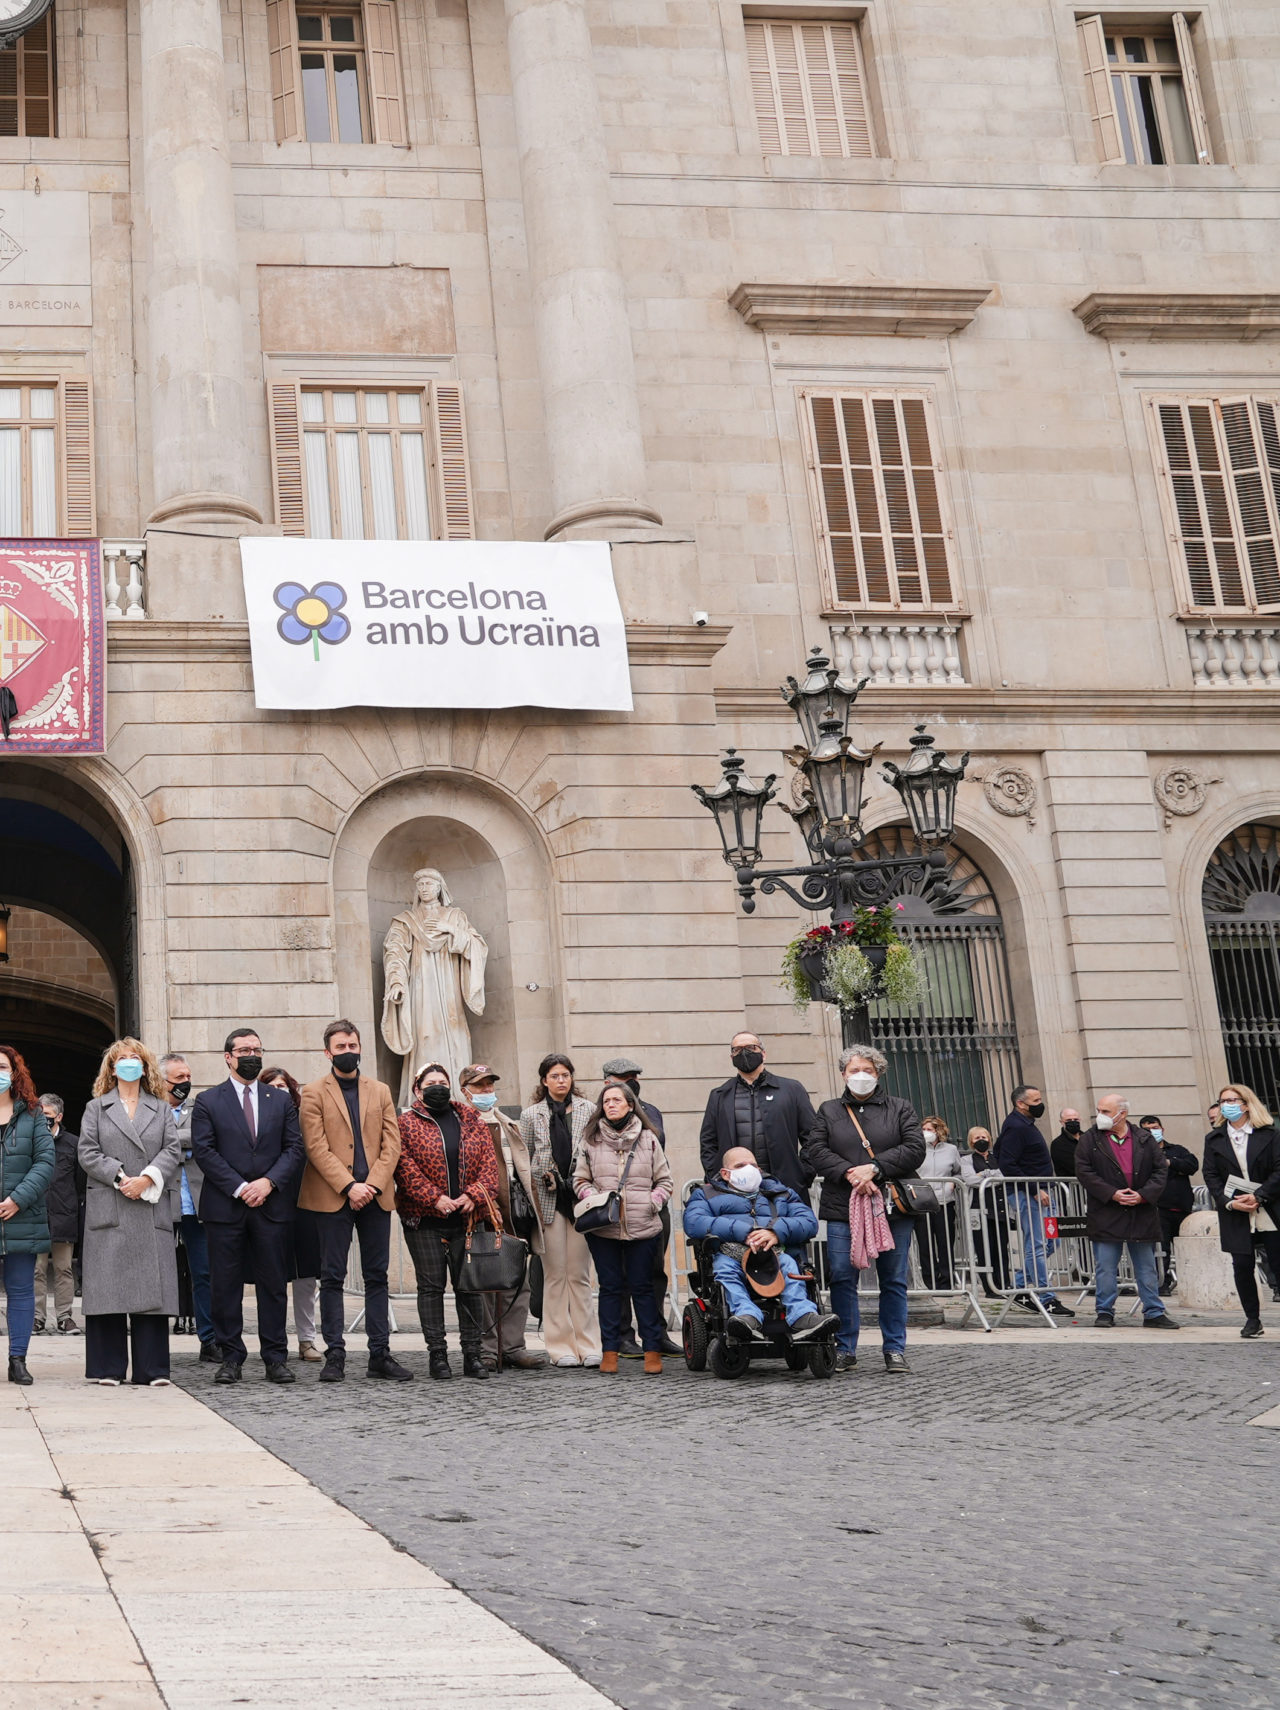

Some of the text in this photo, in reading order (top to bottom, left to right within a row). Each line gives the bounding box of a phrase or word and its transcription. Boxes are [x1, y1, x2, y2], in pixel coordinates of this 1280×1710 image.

[8, 300, 81, 310] BARCELONA
[361, 581, 547, 611] Barcelona
[366, 614, 600, 648] amb Ucraïna
